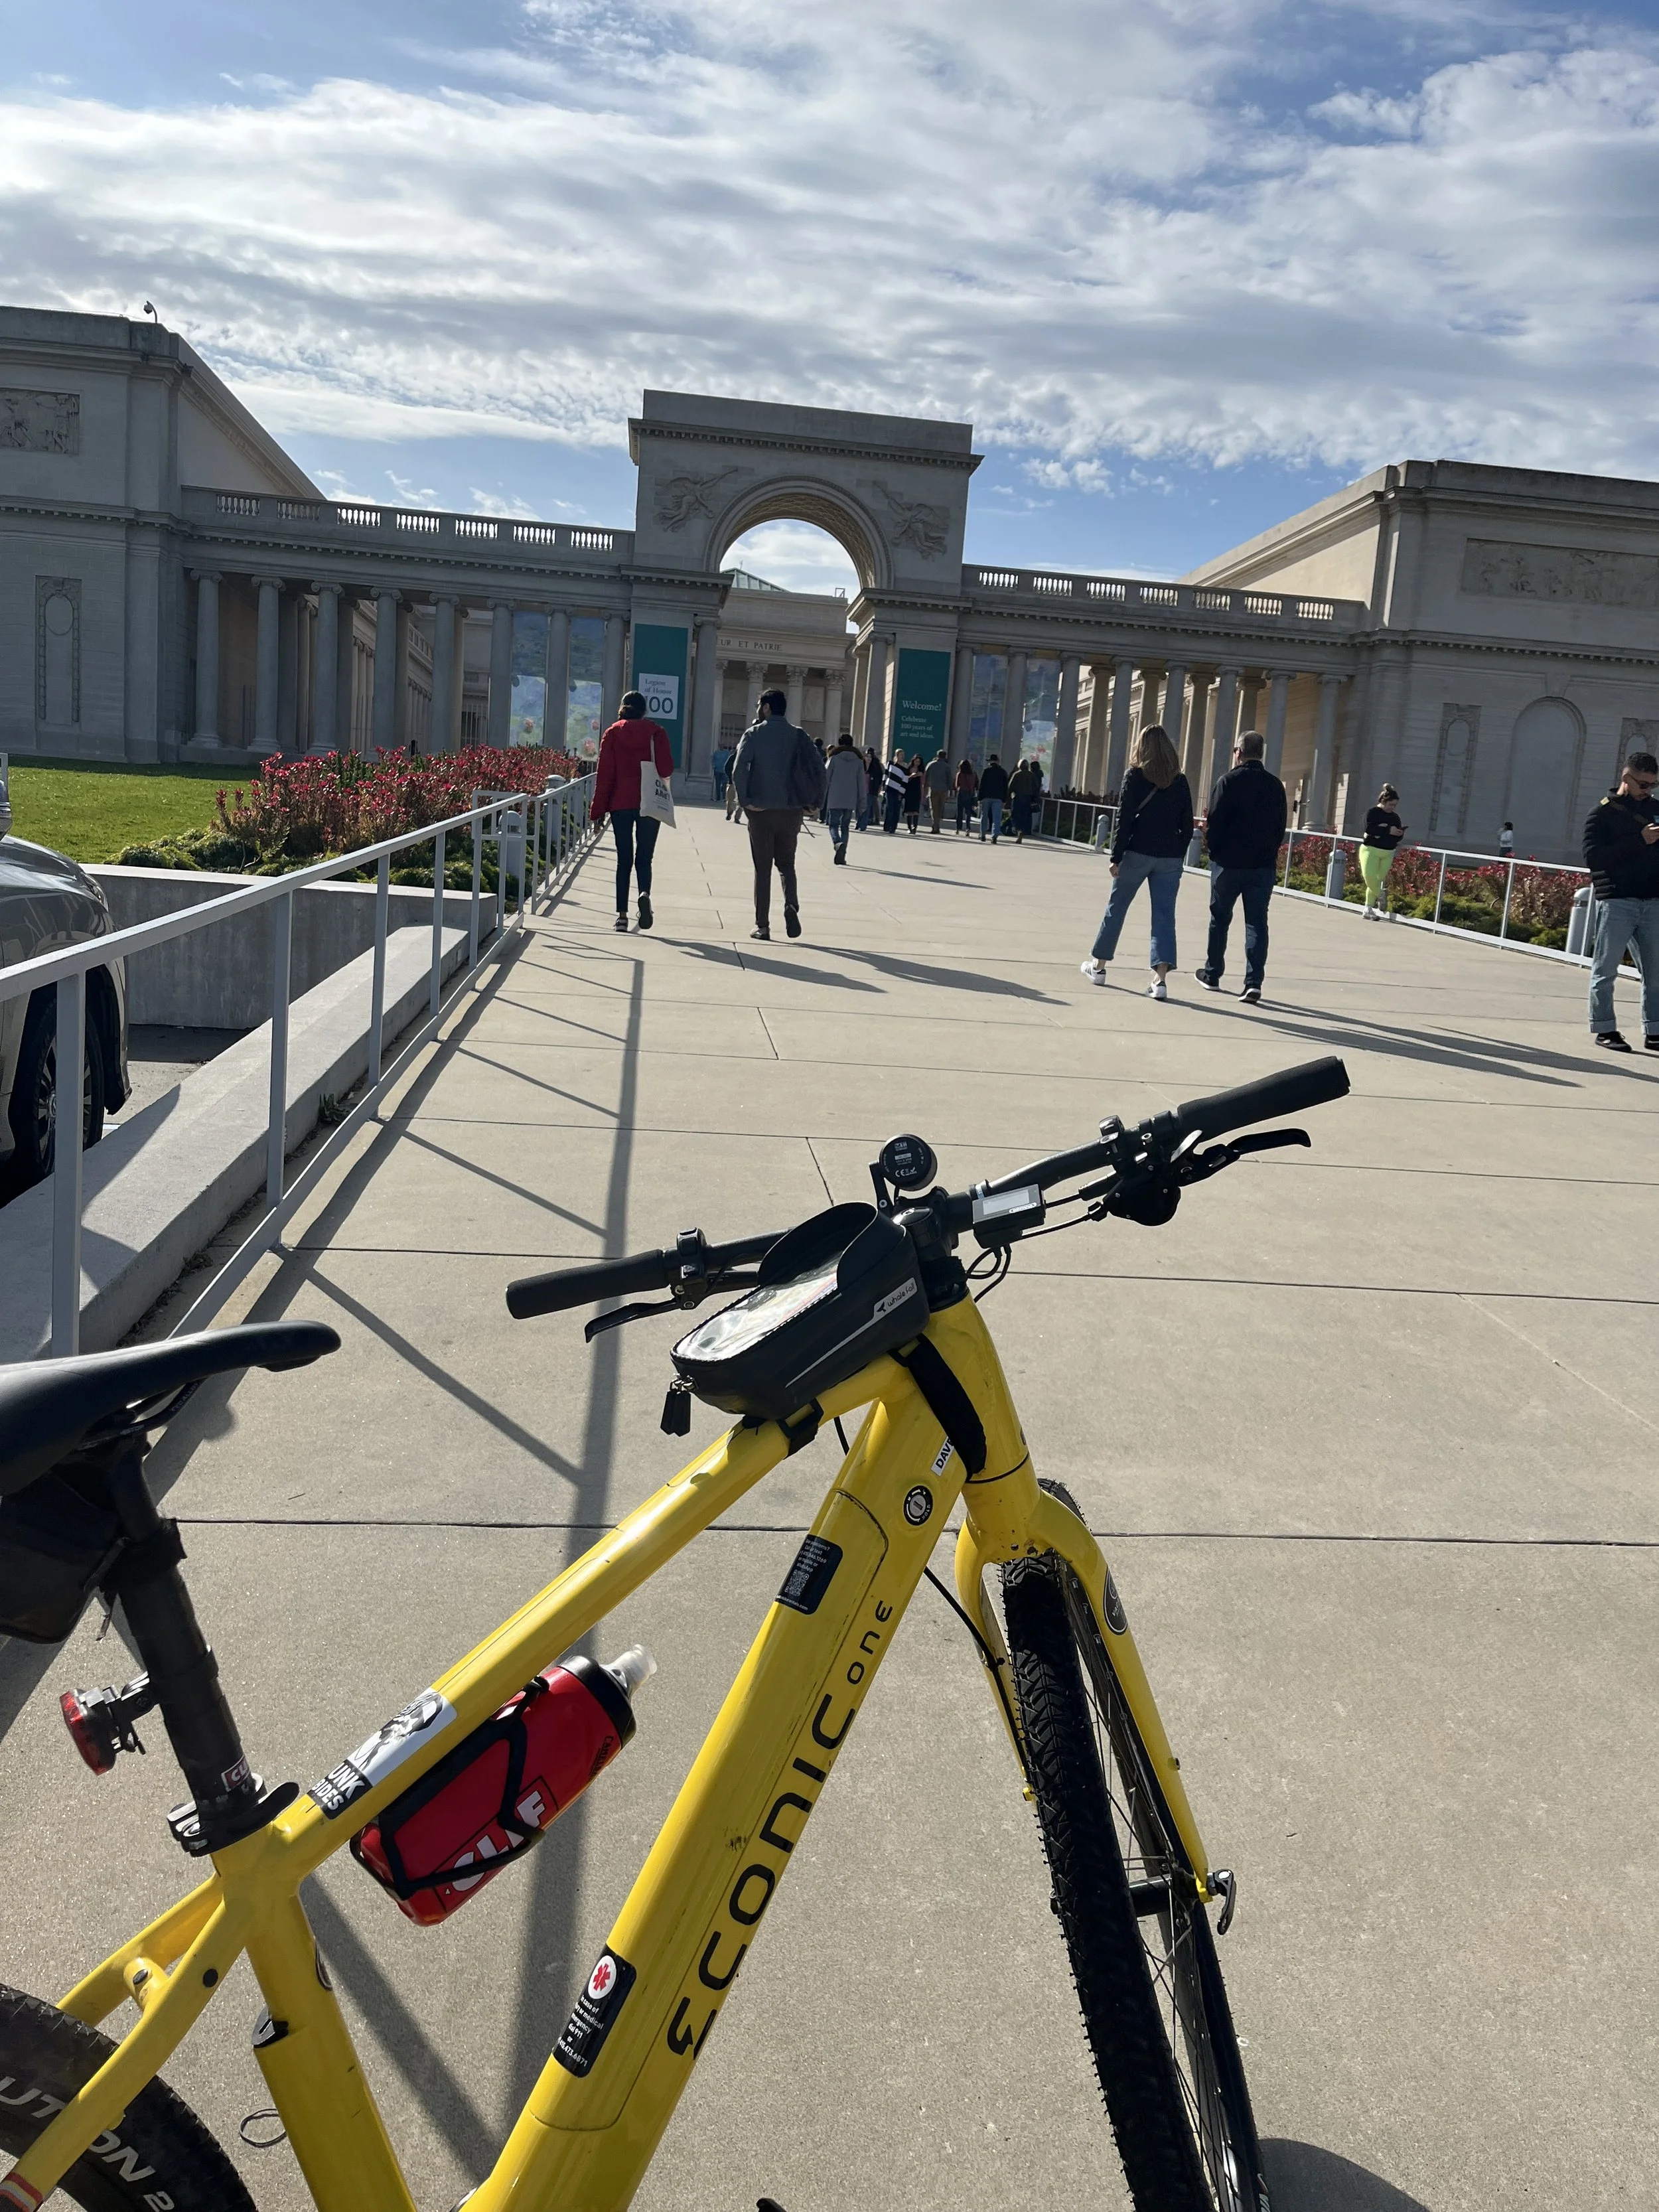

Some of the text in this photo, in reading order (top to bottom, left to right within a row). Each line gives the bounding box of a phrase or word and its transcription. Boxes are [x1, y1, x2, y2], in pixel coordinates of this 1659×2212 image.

[754, 642, 782, 651] PATRIE
[902, 700, 942, 711] Welcome!
[887, 1291, 906, 1307] whale
[935, 1438, 952, 1469] DAV
[583, 2012, 605, 2030] medical
[574, 2028, 583, 2039] 911
